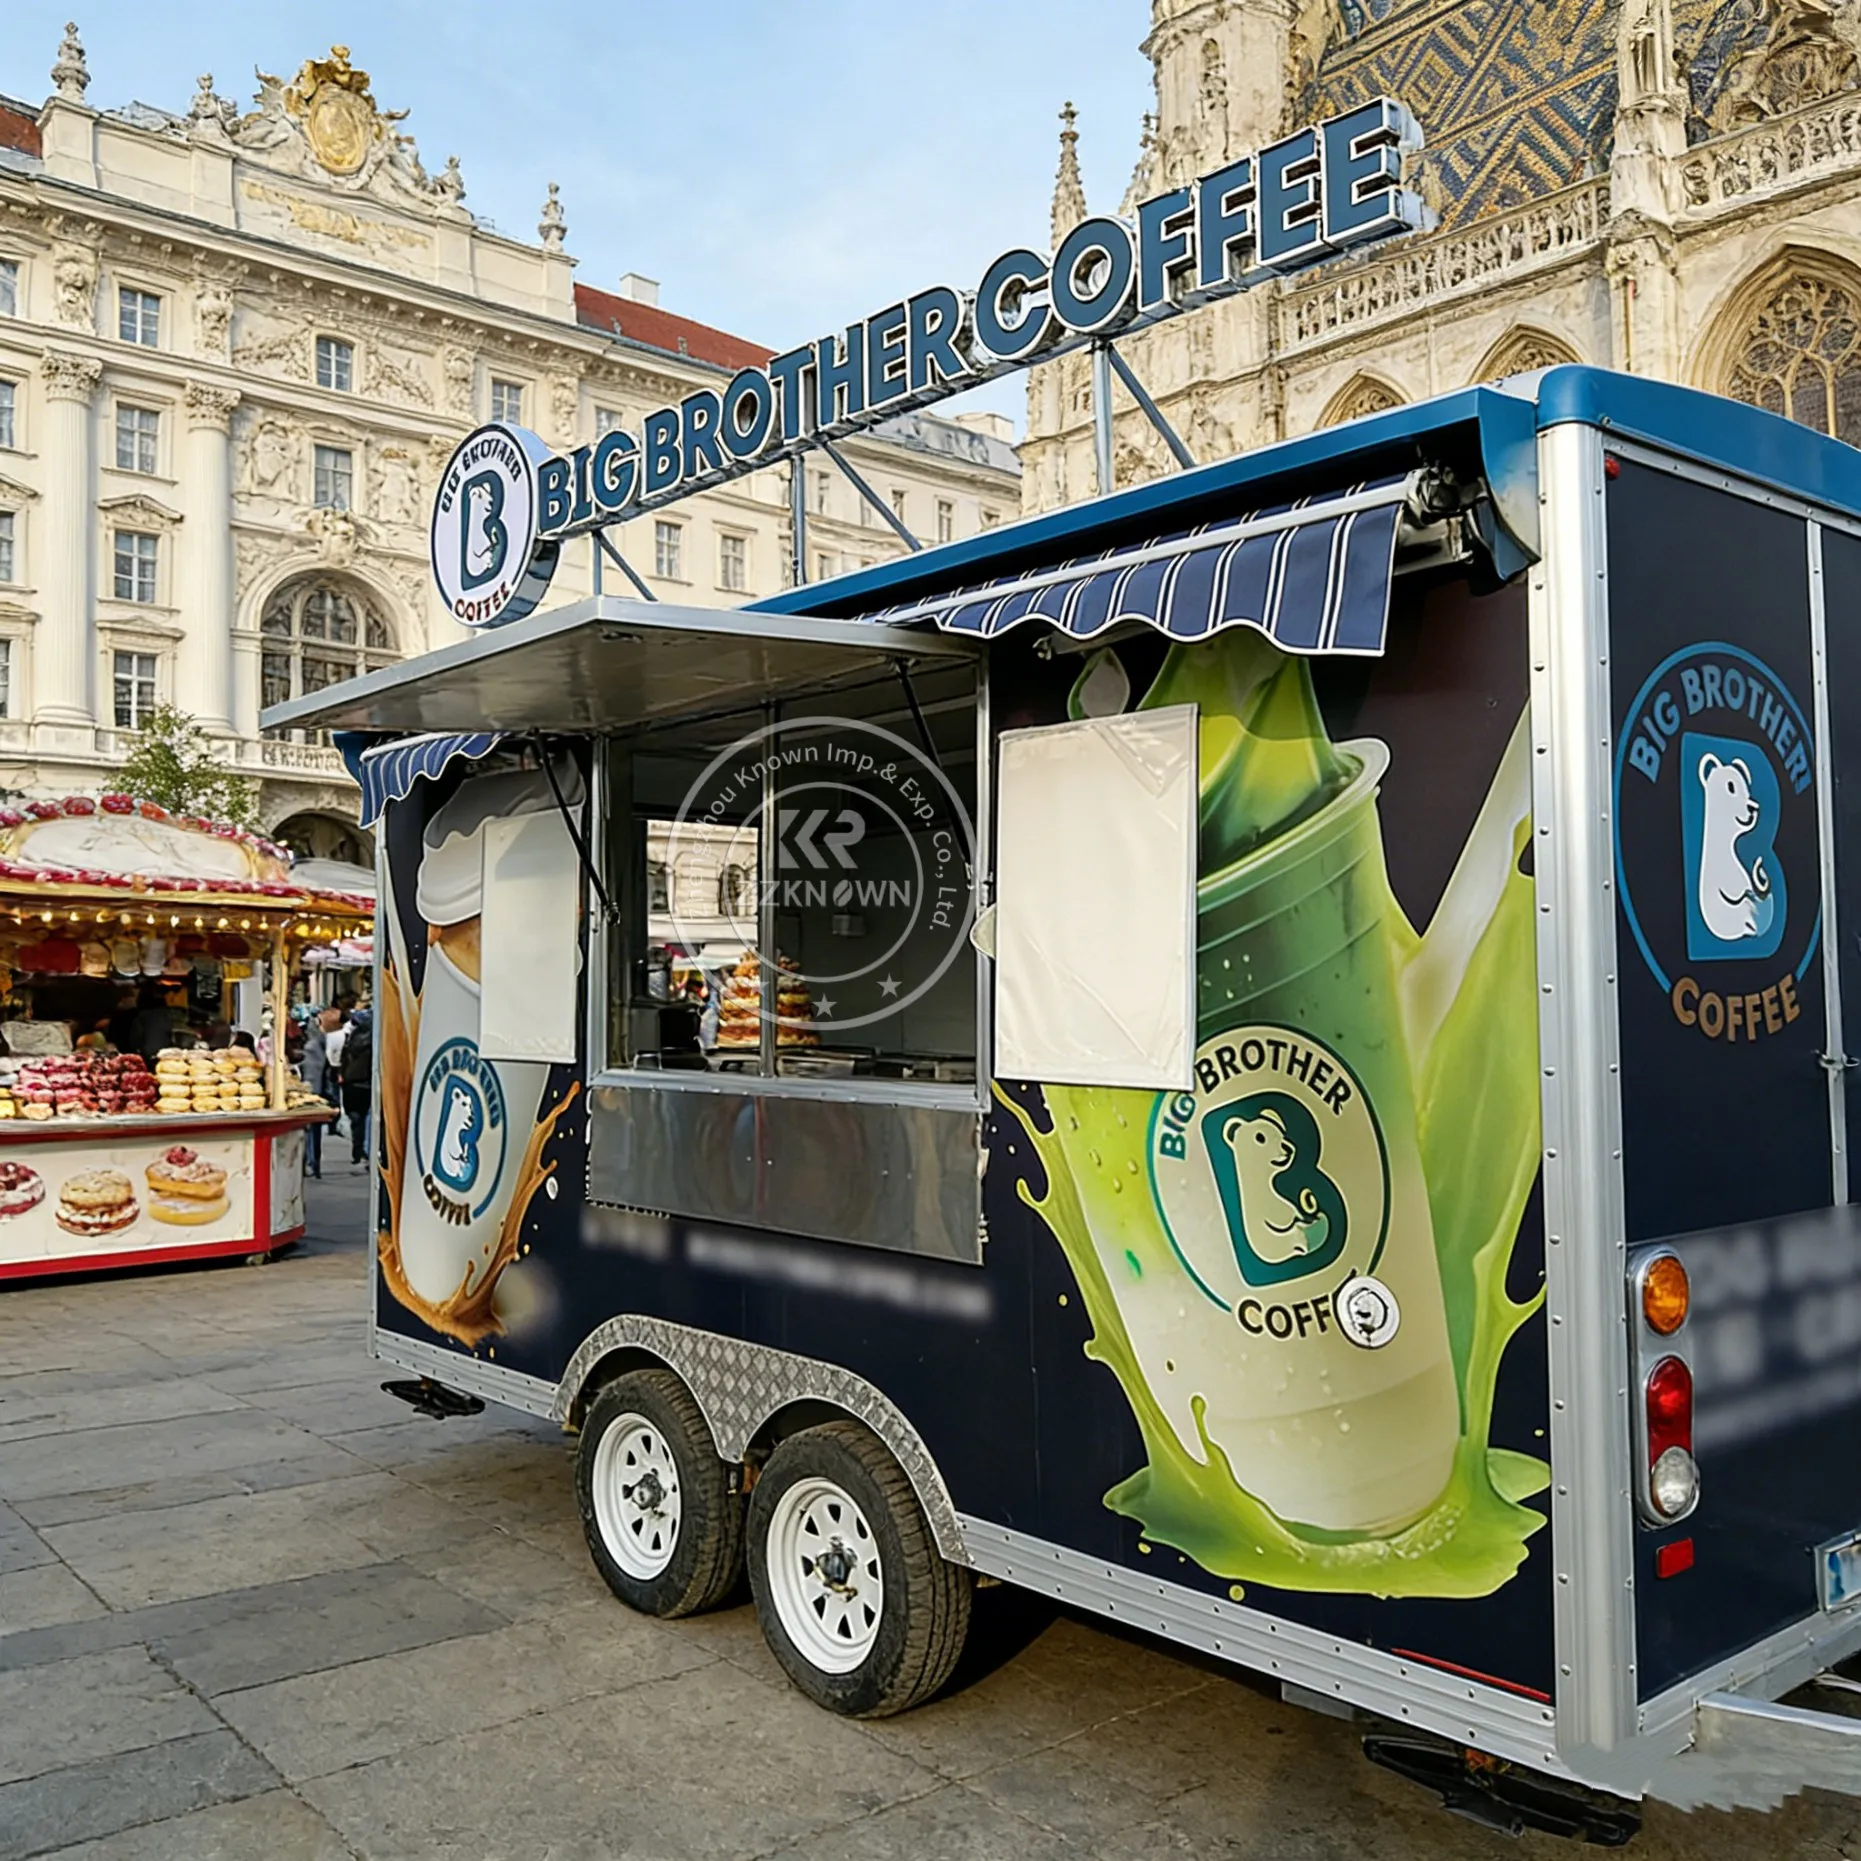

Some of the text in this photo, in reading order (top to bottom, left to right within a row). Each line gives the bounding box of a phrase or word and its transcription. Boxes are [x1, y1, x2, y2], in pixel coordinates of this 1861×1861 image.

[537, 96, 1404, 537] BIG BROTHER COFFEE
[1628, 664, 1812, 795] BIG BROTHER
[1672, 972, 1801, 1043] COFFEE
[1160, 1038, 1352, 1161] BIG BROTHER
